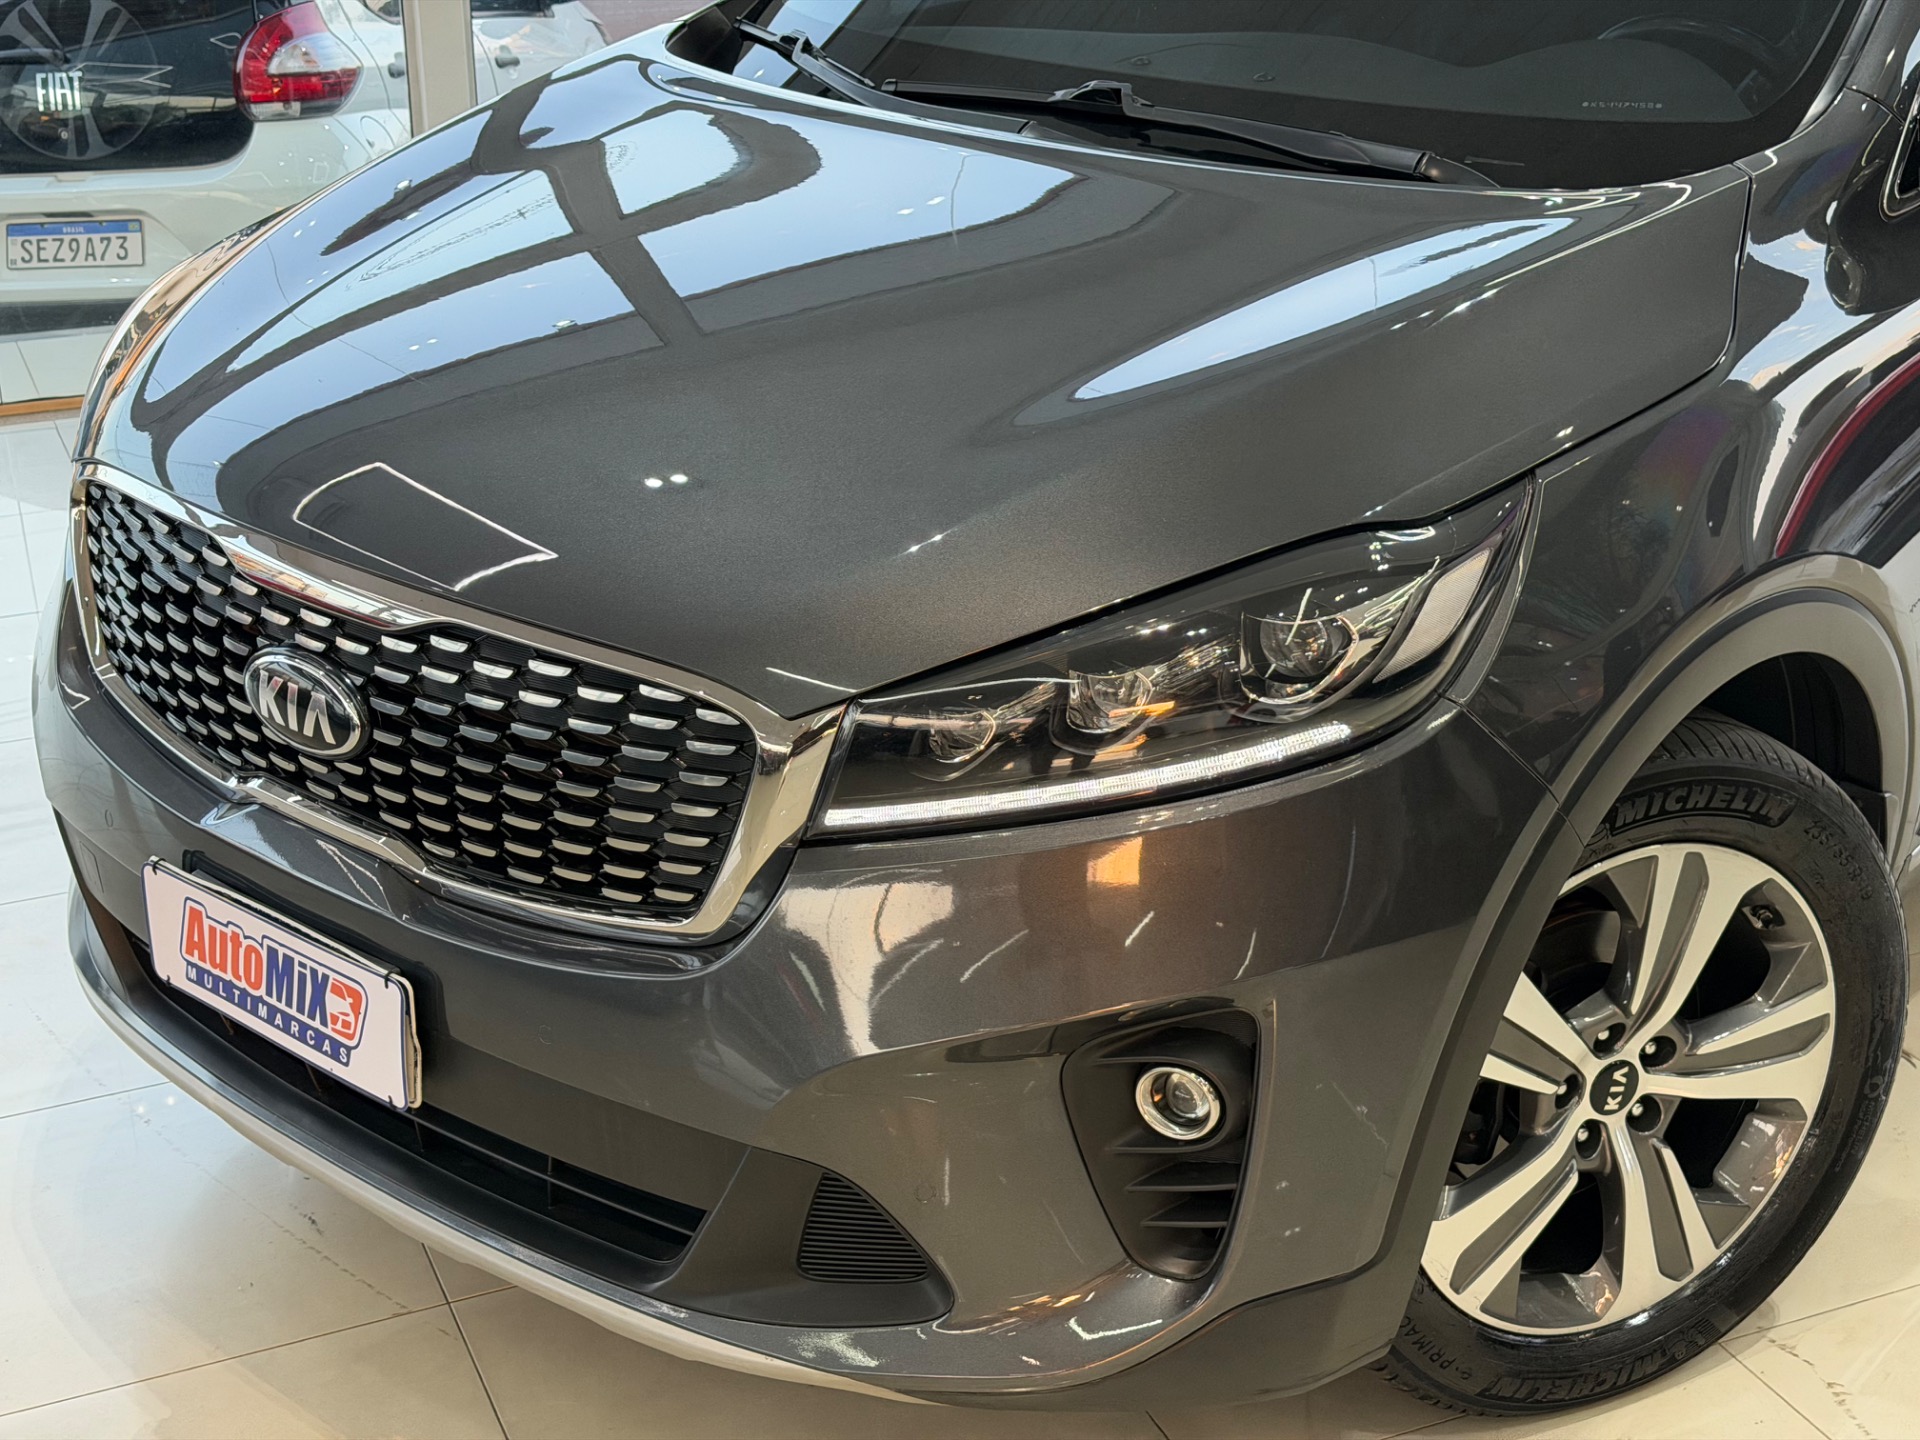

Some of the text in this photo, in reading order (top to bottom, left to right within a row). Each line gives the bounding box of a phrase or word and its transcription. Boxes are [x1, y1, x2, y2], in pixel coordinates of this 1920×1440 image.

[36, 71, 82, 112] FIAT
[20, 236, 129, 264] SEZ9A73
[259, 669, 337, 745] KIA
[1615, 784, 1795, 828] MICHELIN
[187, 965, 348, 1064] MULTIMARCAS
[1603, 1065, 1630, 1111] KIA
[1488, 1349, 1662, 1402] MICHELIN
